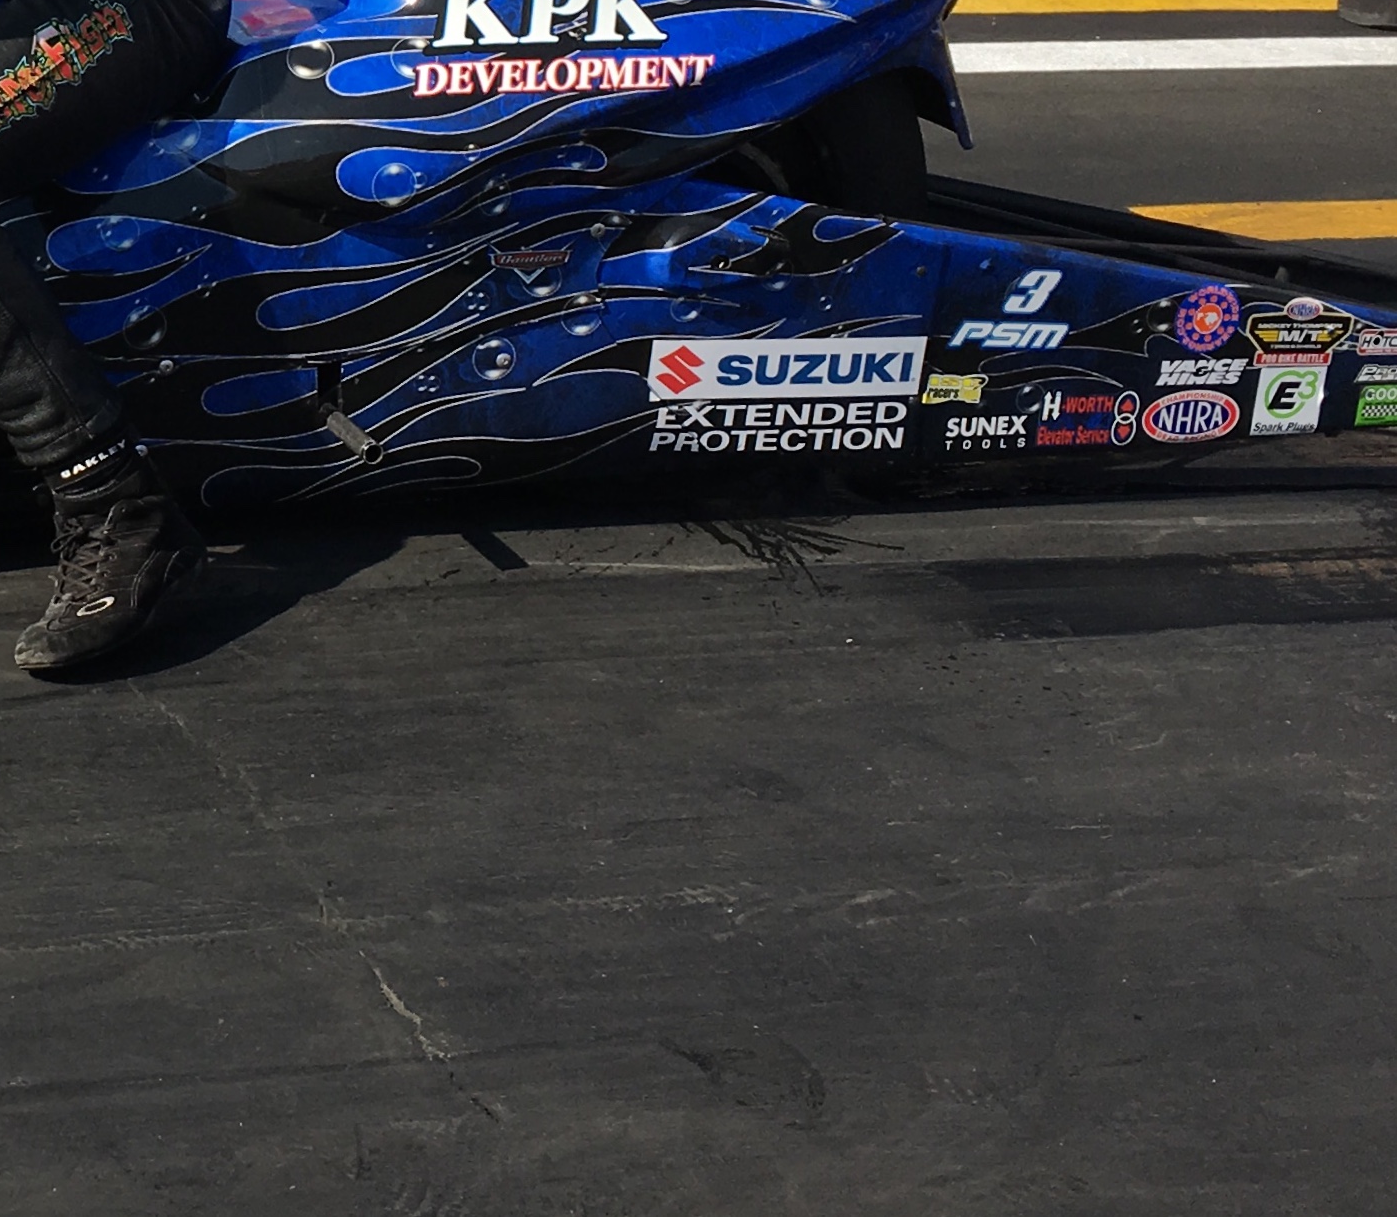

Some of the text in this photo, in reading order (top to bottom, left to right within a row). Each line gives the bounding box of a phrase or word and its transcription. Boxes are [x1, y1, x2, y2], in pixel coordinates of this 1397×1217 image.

[412, 54, 714, 98] DEVELOPMENT
[1004, 268, 1063, 314] 3
[948, 320, 1070, 348] PSM
[1278, 329, 1322, 343] M/T
[715, 351, 915, 385] SUZUKI
[1160, 358, 1249, 373] VANCE
[1296, 353, 1326, 363] BATTLE
[1155, 371, 1242, 387] HINES
[654, 401, 908, 430] EXTENDED
[944, 415, 1028, 438] SUNEX
[1158, 401, 1223, 434] NHRA
[1253, 421, 1286, 434] Spark
[648, 426, 905, 453] PROTECTION
[944, 437, 1027, 451] TOOLS
[59, 439, 127, 480] OAKLEY
